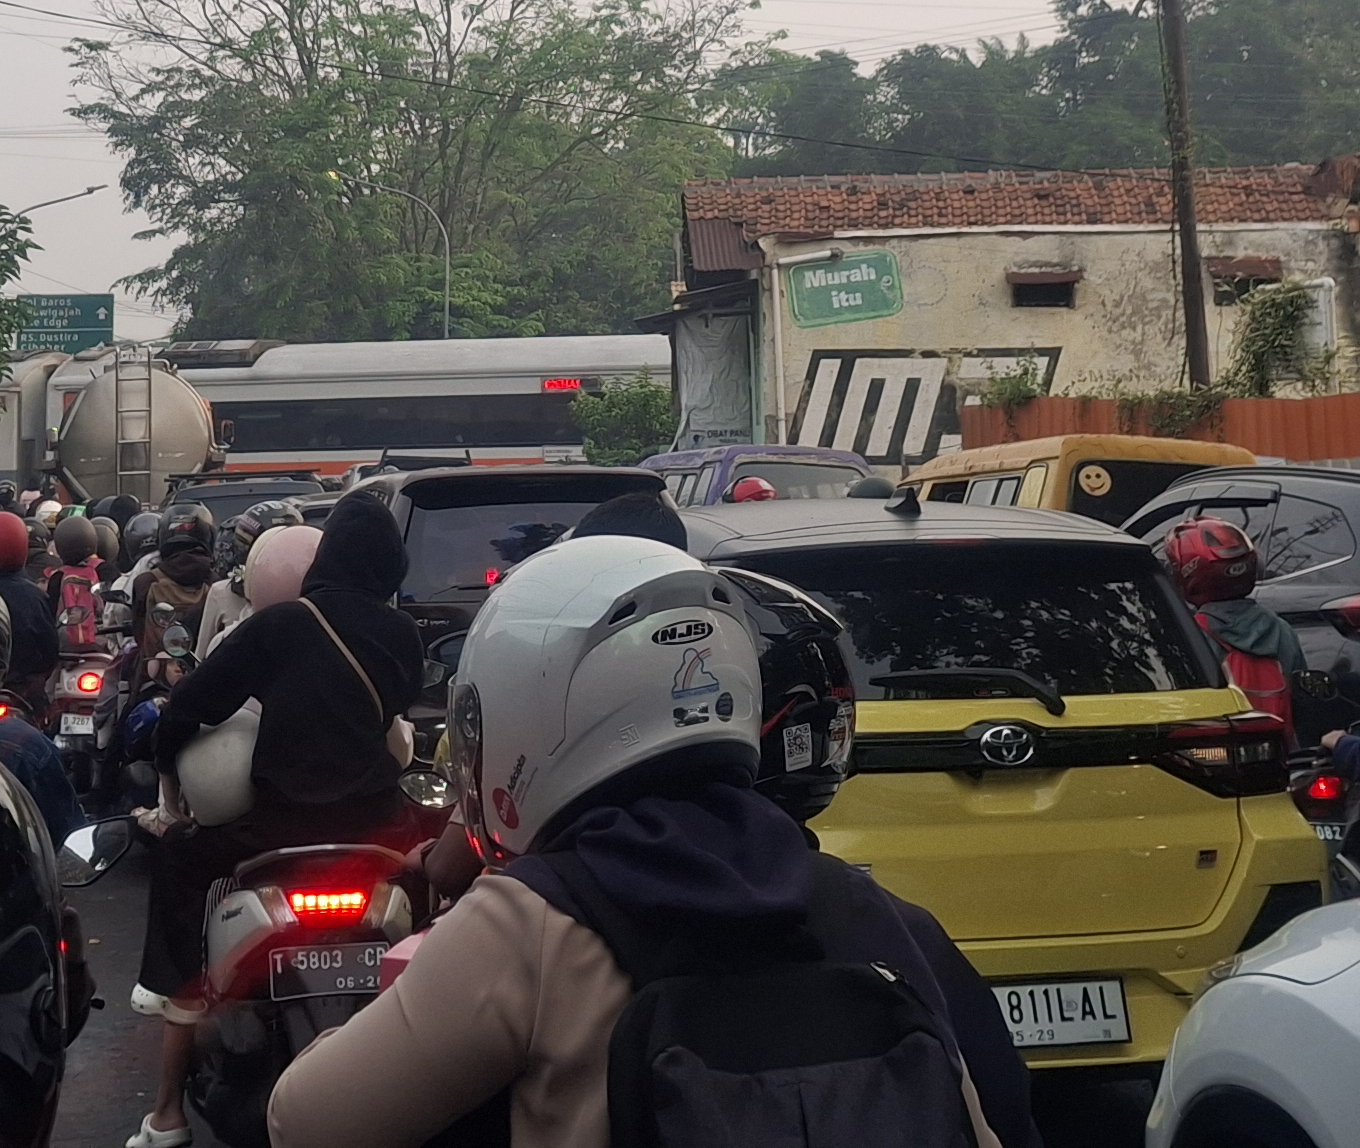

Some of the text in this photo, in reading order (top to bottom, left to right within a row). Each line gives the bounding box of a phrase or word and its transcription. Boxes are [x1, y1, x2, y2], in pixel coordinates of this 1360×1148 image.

[805, 263, 876, 289] Murah
[40, 298, 72, 307] Baros
[831, 288, 863, 309] itu
[43, 318, 69, 328] Edge
[40, 333, 79, 342] Dustira
[659, 622, 707, 642] NJS
[272, 953, 283, 974] T
[296, 949, 343, 971] 5803
